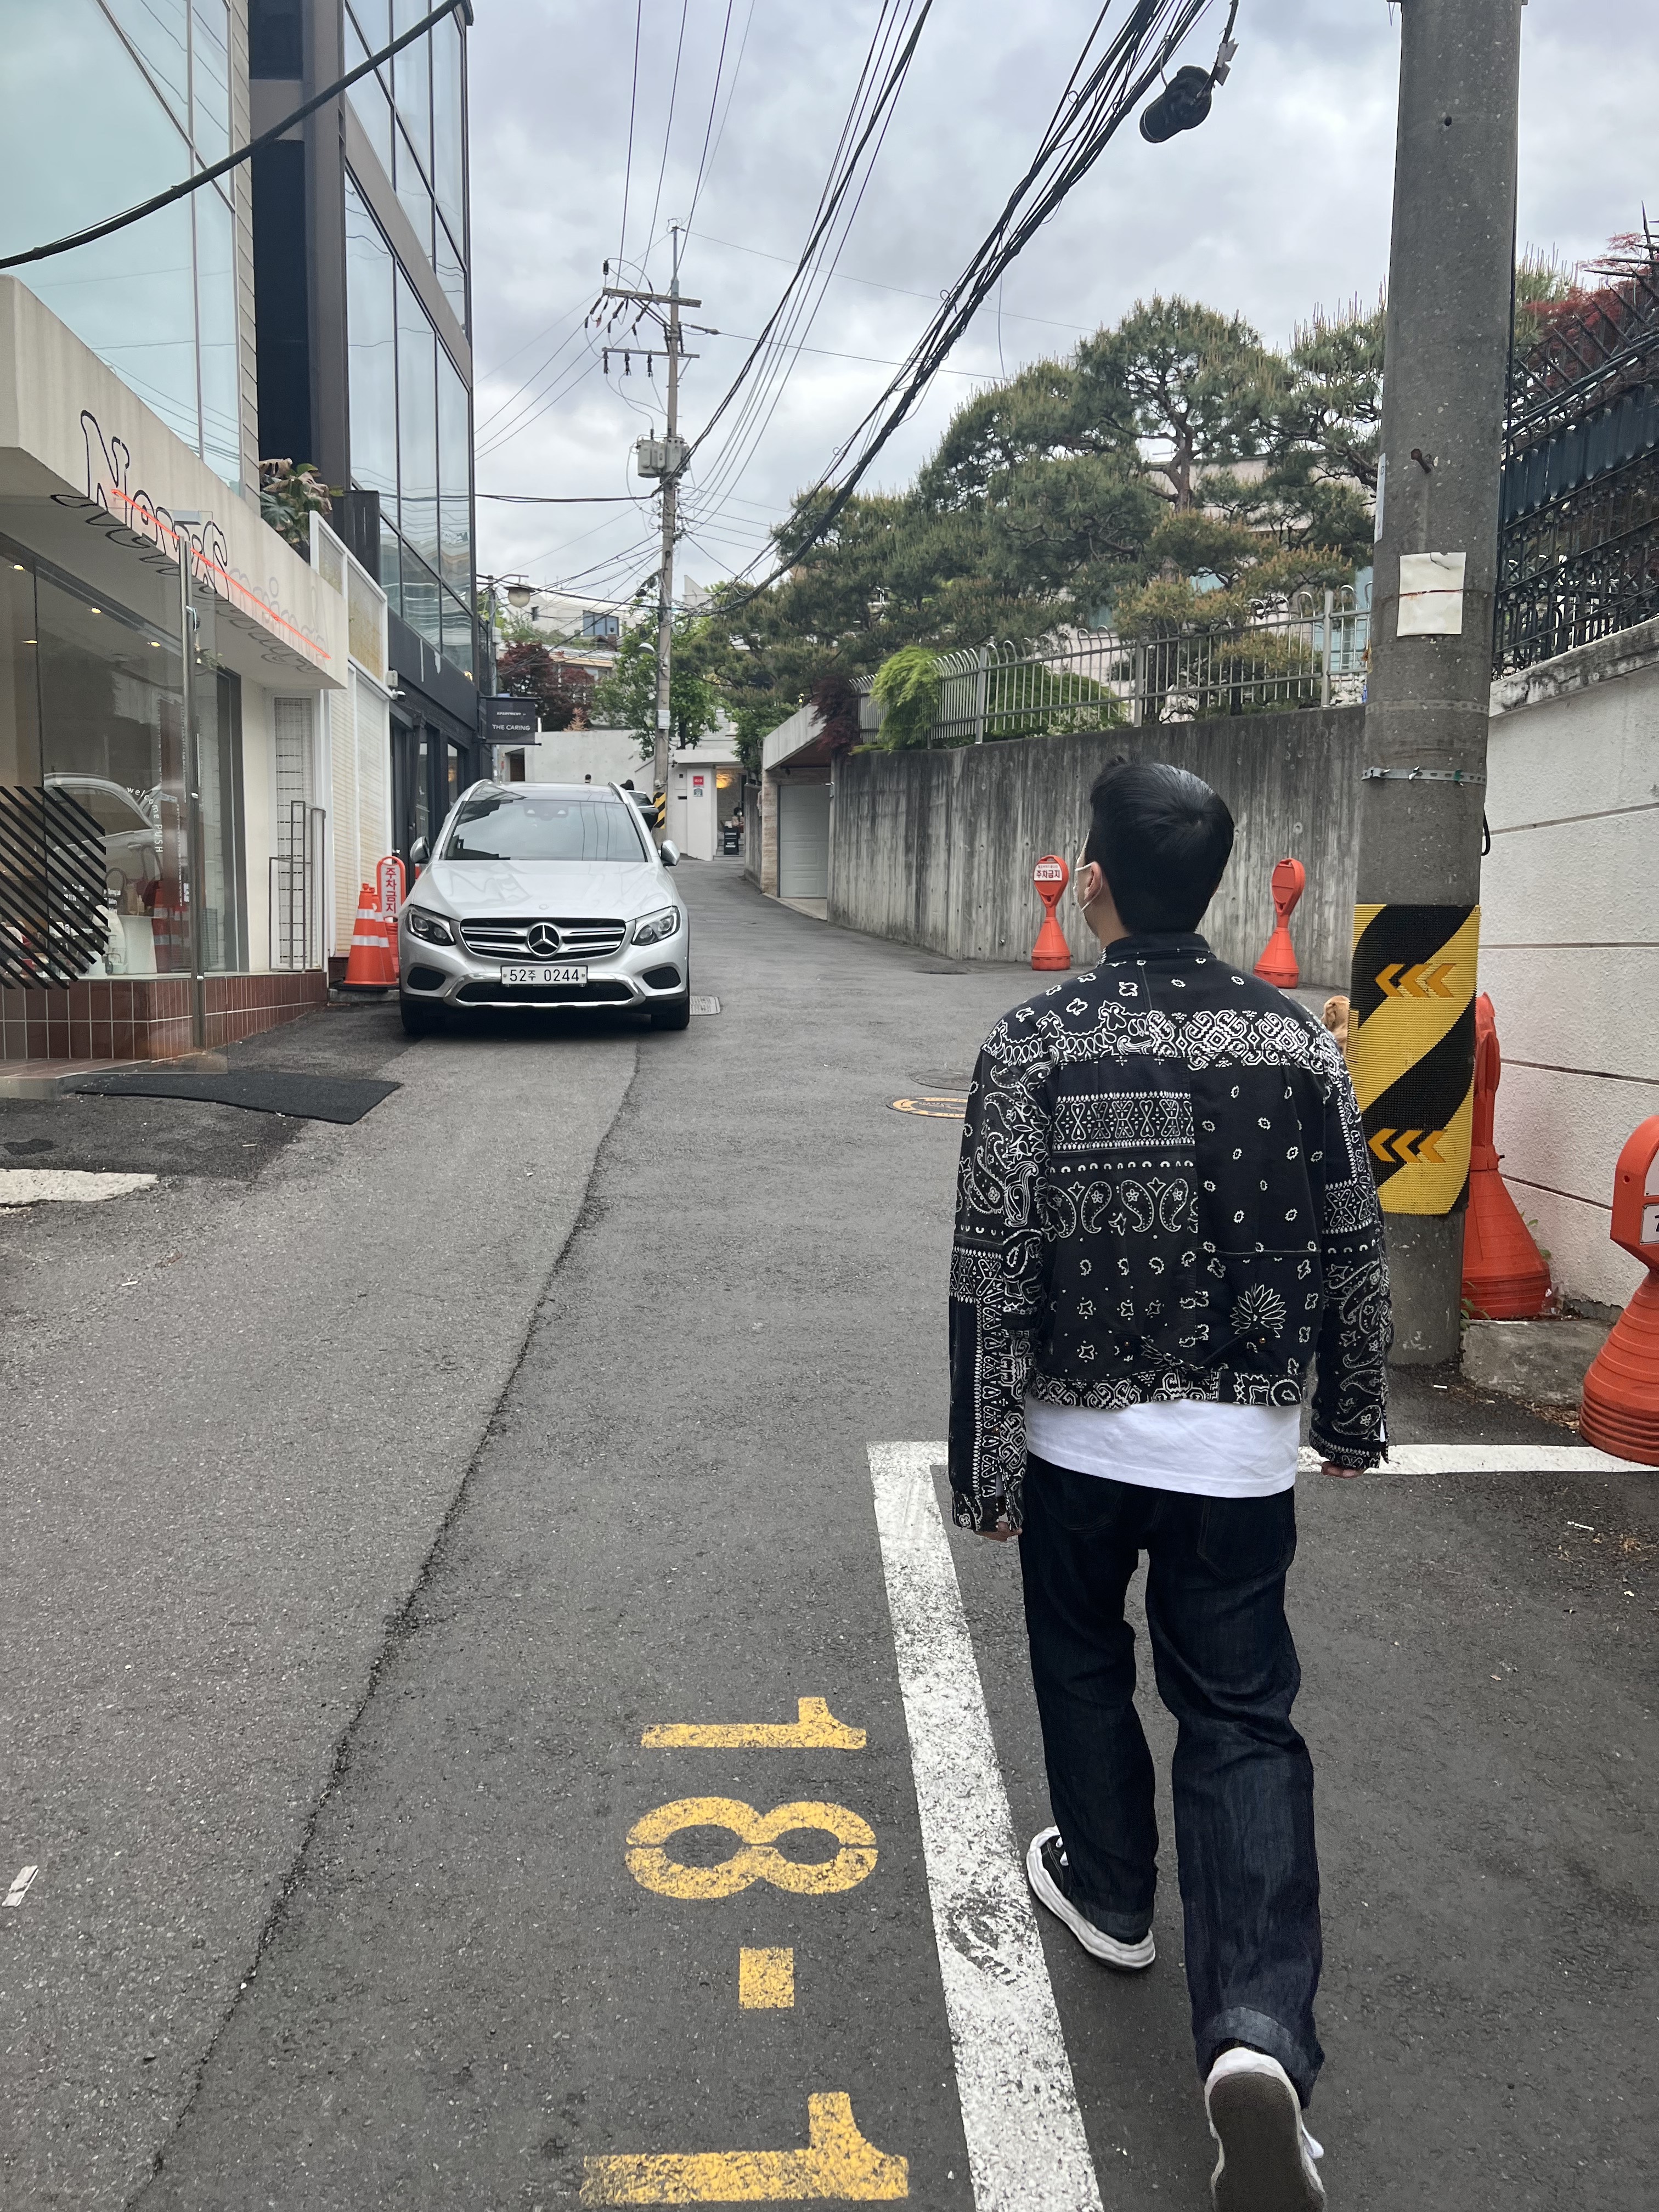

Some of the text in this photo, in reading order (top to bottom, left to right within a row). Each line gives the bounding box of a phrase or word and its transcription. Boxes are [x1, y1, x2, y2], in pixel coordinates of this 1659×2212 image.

[127, 787, 163, 853] welcome PUSH
[1036, 870, 1060, 878] 주차금지
[386, 867, 397, 914] 주차금지
[510, 969, 579, 981] 52주 0244
